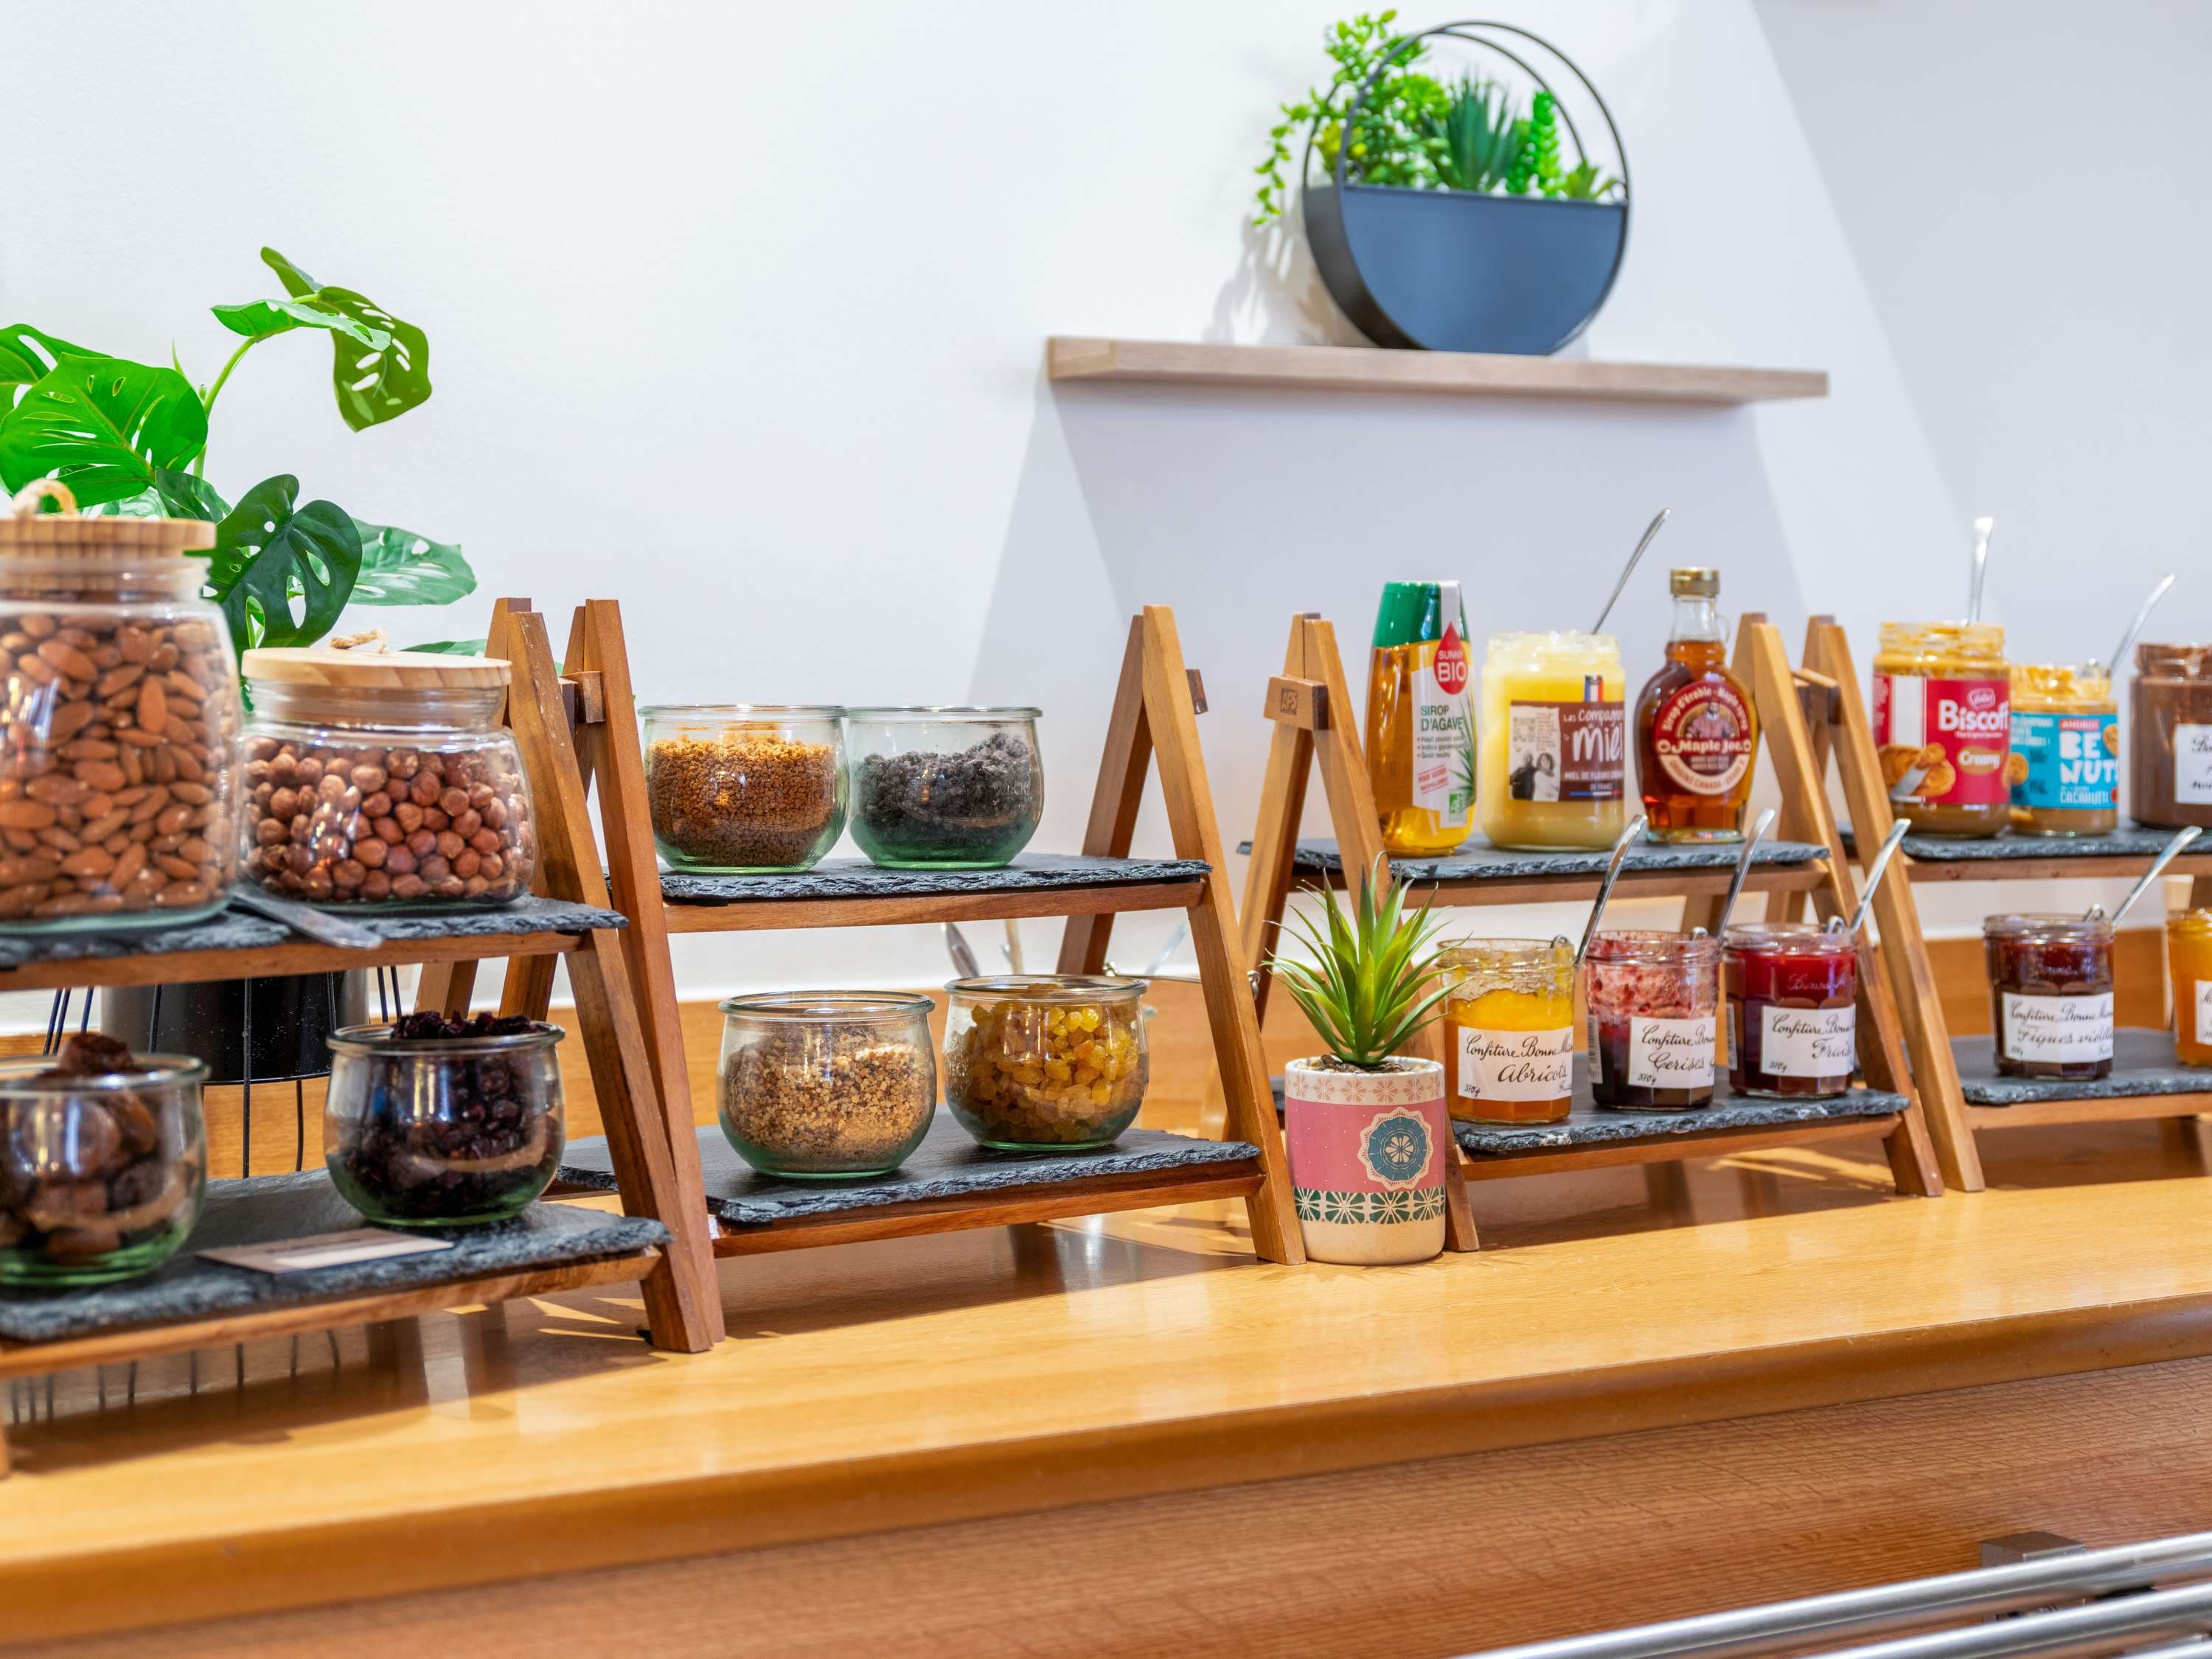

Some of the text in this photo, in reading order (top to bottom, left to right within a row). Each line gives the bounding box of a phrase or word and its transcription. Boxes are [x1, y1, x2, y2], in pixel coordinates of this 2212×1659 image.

[1439, 650, 1464, 660] SUNNY
[1439, 661, 1467, 682] BIO
[1421, 704, 1450, 716] SIROP
[1421, 717, 1463, 732] D'AGAVE
[1672, 740, 1722, 754] Maple
[2059, 730, 2101, 759] BE
[1958, 750, 2000, 770] Creamy
[2010, 1000, 2057, 1024] Confiture
[1642, 1024, 1694, 1050] Confiture
[1773, 1014, 1825, 1039] Confiture
[1467, 1034, 1519, 1061] Confiture
[1521, 1035, 1557, 1057] Bonne
[1498, 1062, 1568, 1083] Abricots
[1648, 1052, 1705, 1074] Cerises
